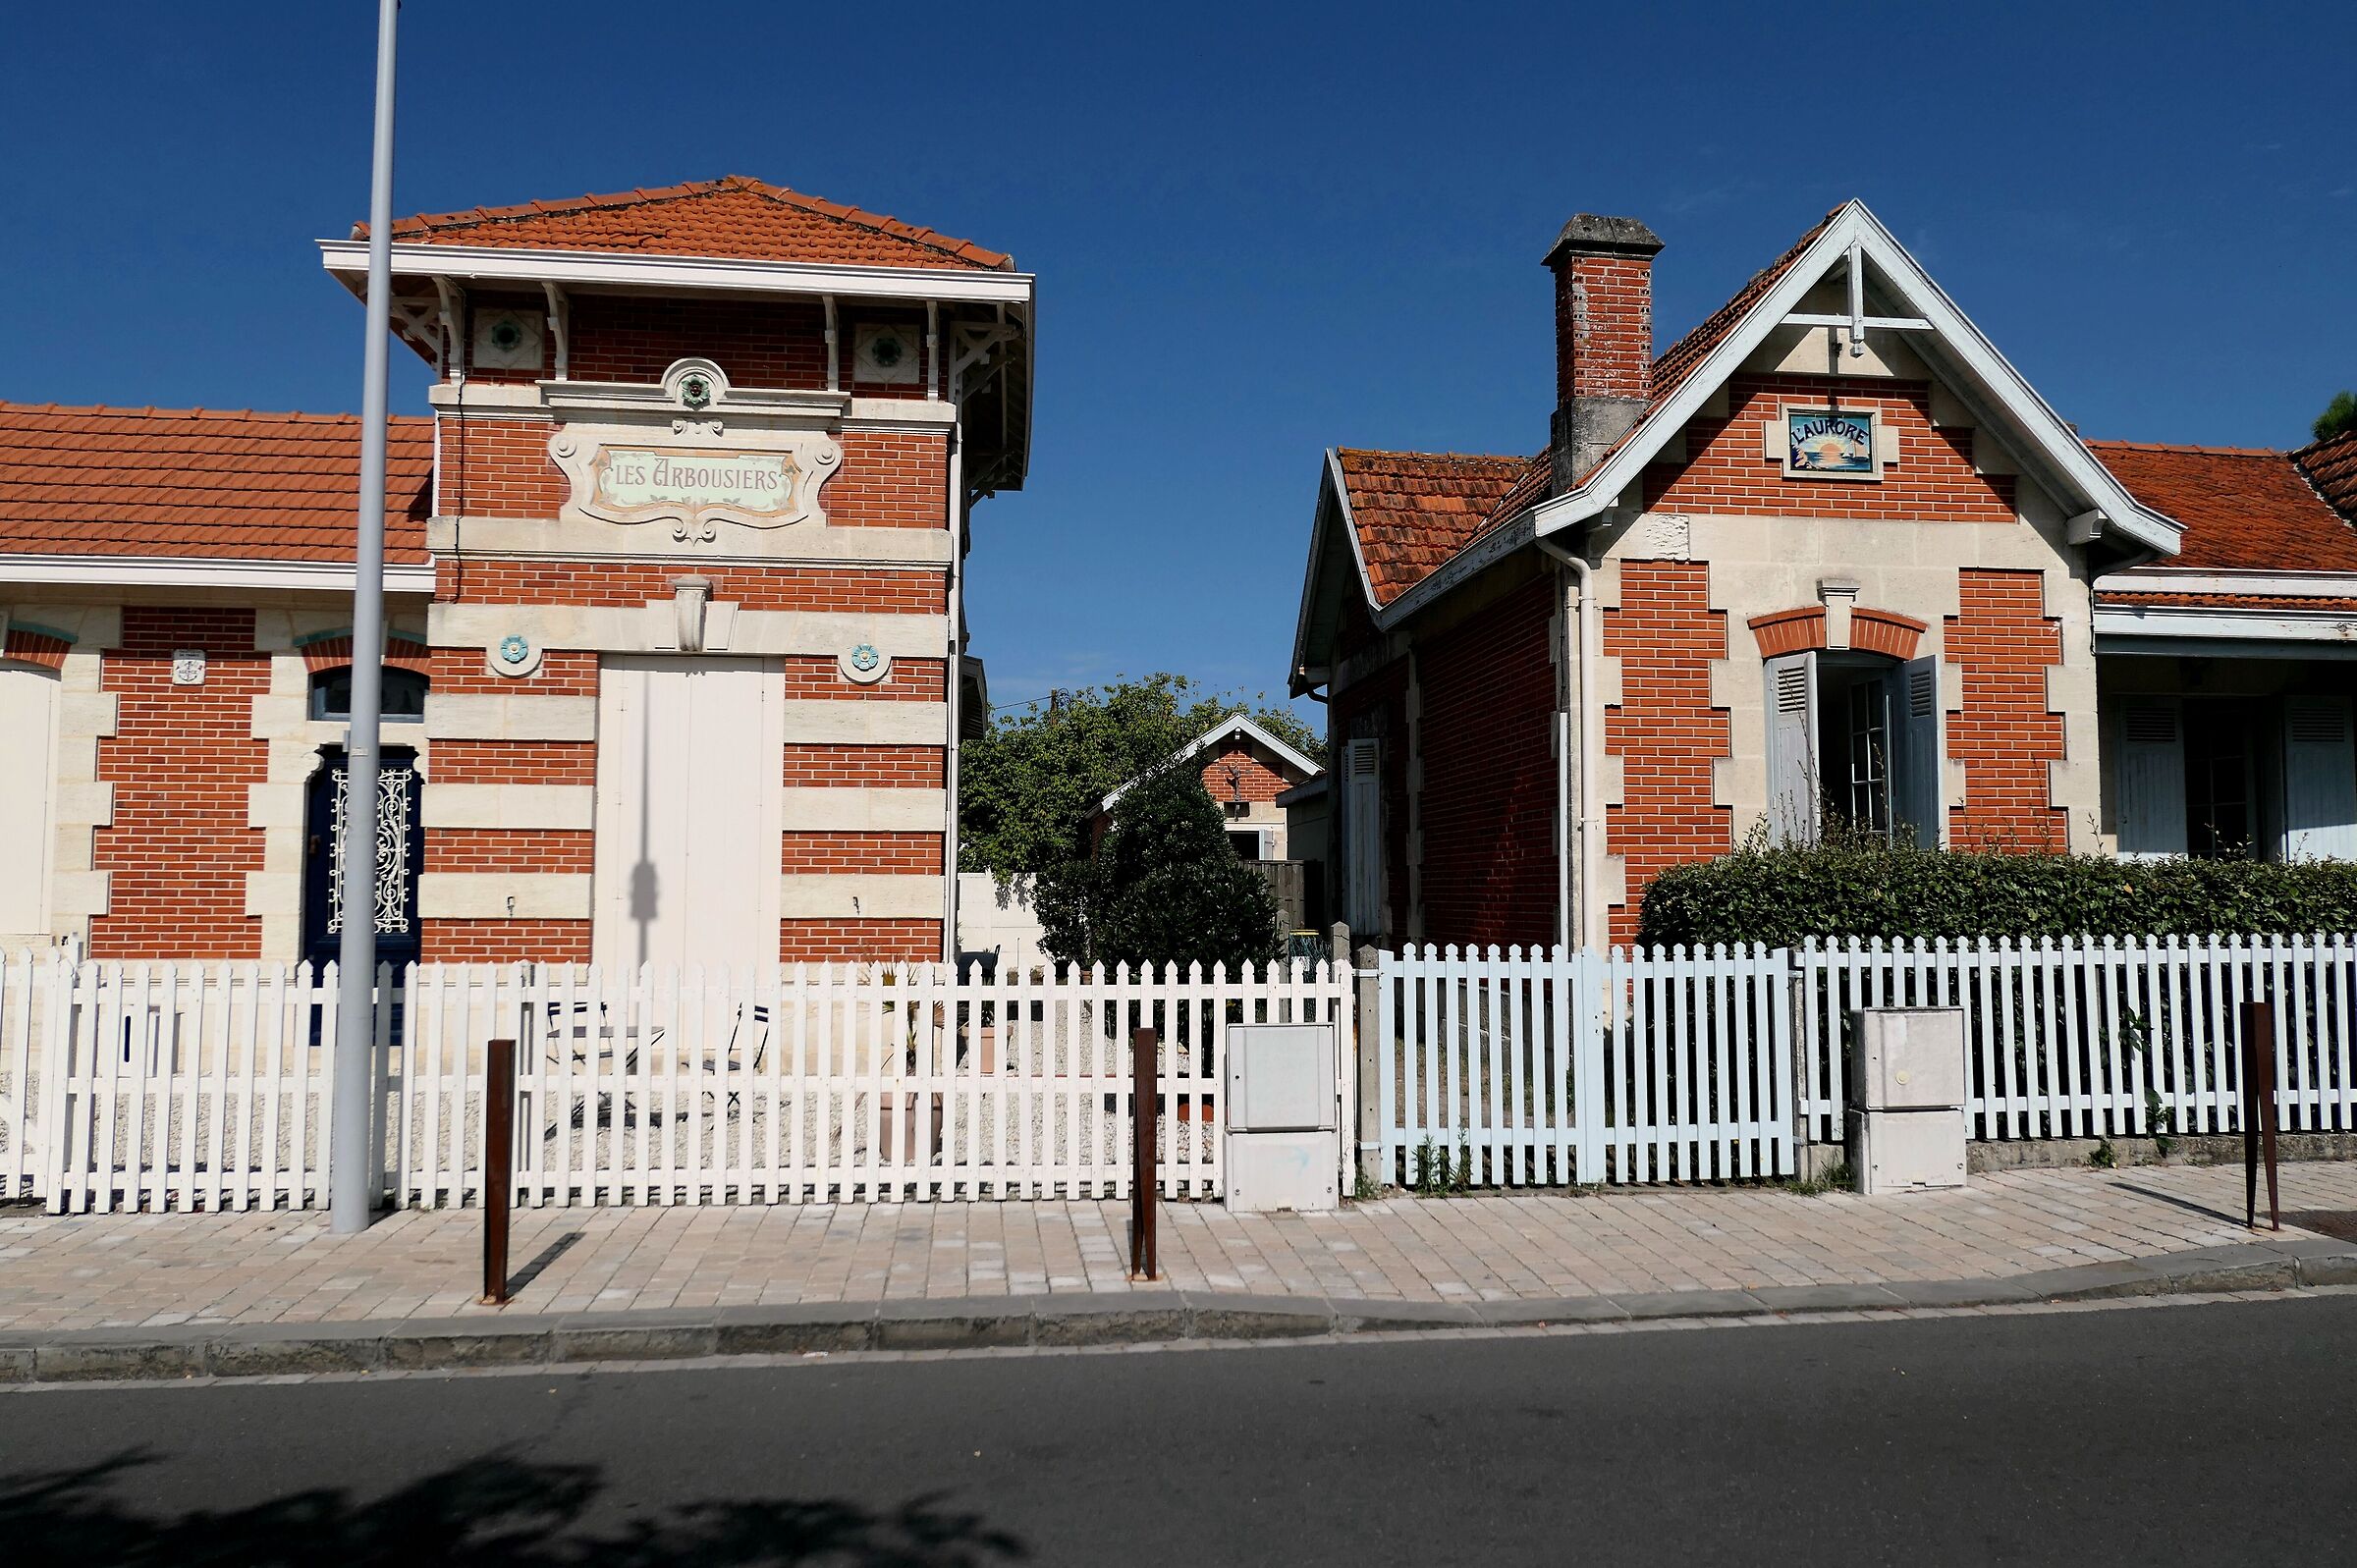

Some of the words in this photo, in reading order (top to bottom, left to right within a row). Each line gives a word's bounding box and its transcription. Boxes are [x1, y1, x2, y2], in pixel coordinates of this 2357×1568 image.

[1791, 419, 1869, 445] L'AURORE
[616, 464, 646, 485] LES
[652, 458, 779, 492] ARBOUSIERS
